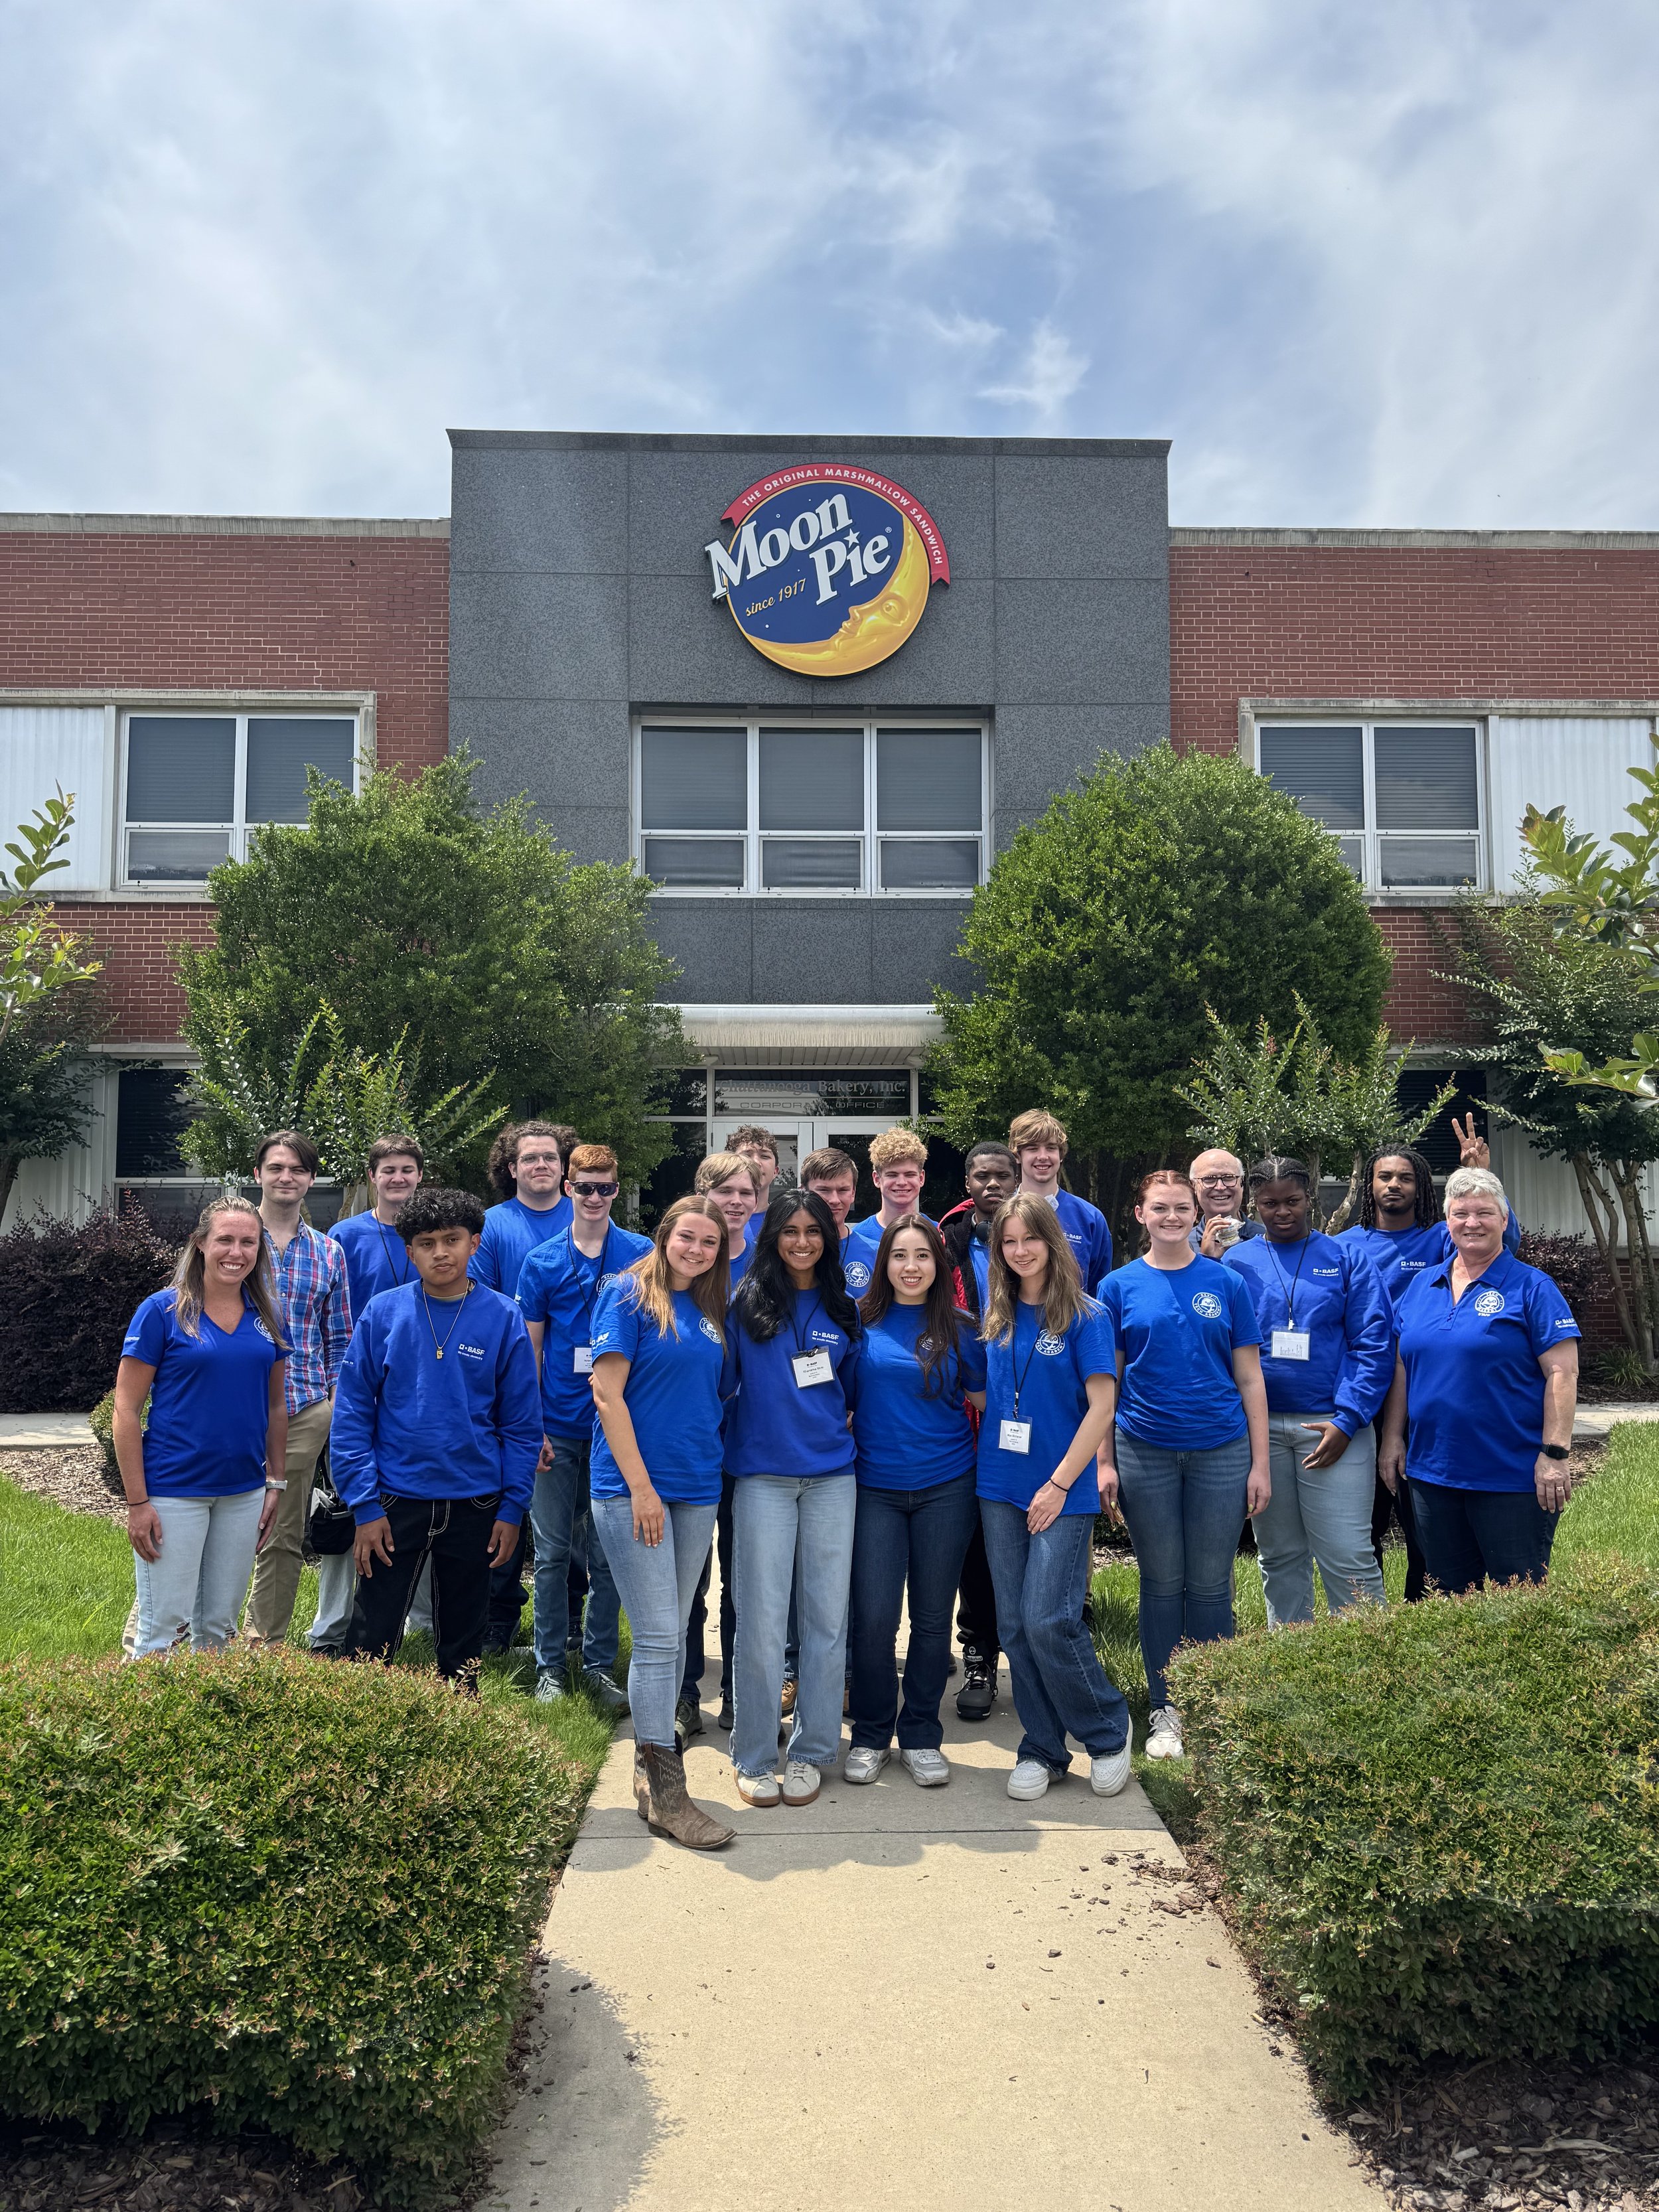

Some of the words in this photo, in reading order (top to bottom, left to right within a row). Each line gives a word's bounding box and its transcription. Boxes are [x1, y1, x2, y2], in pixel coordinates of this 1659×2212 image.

[742, 490, 762, 506] THE
[764, 469, 820, 491] ORIGINAL
[825, 468, 910, 506] MARSHMALLOW
[910, 508, 943, 565] SANDWICH
[705, 493, 853, 599] Moon
[809, 529, 891, 605] Pie
[745, 596, 775, 617] since
[778, 578, 806, 603] 1917
[719, 1079, 811, 1096] Chattanooga
[817, 1079, 873, 1096] Bakery,
[879, 1080, 906, 1092] Inc.
[467, 1346, 485, 1355] BASF
